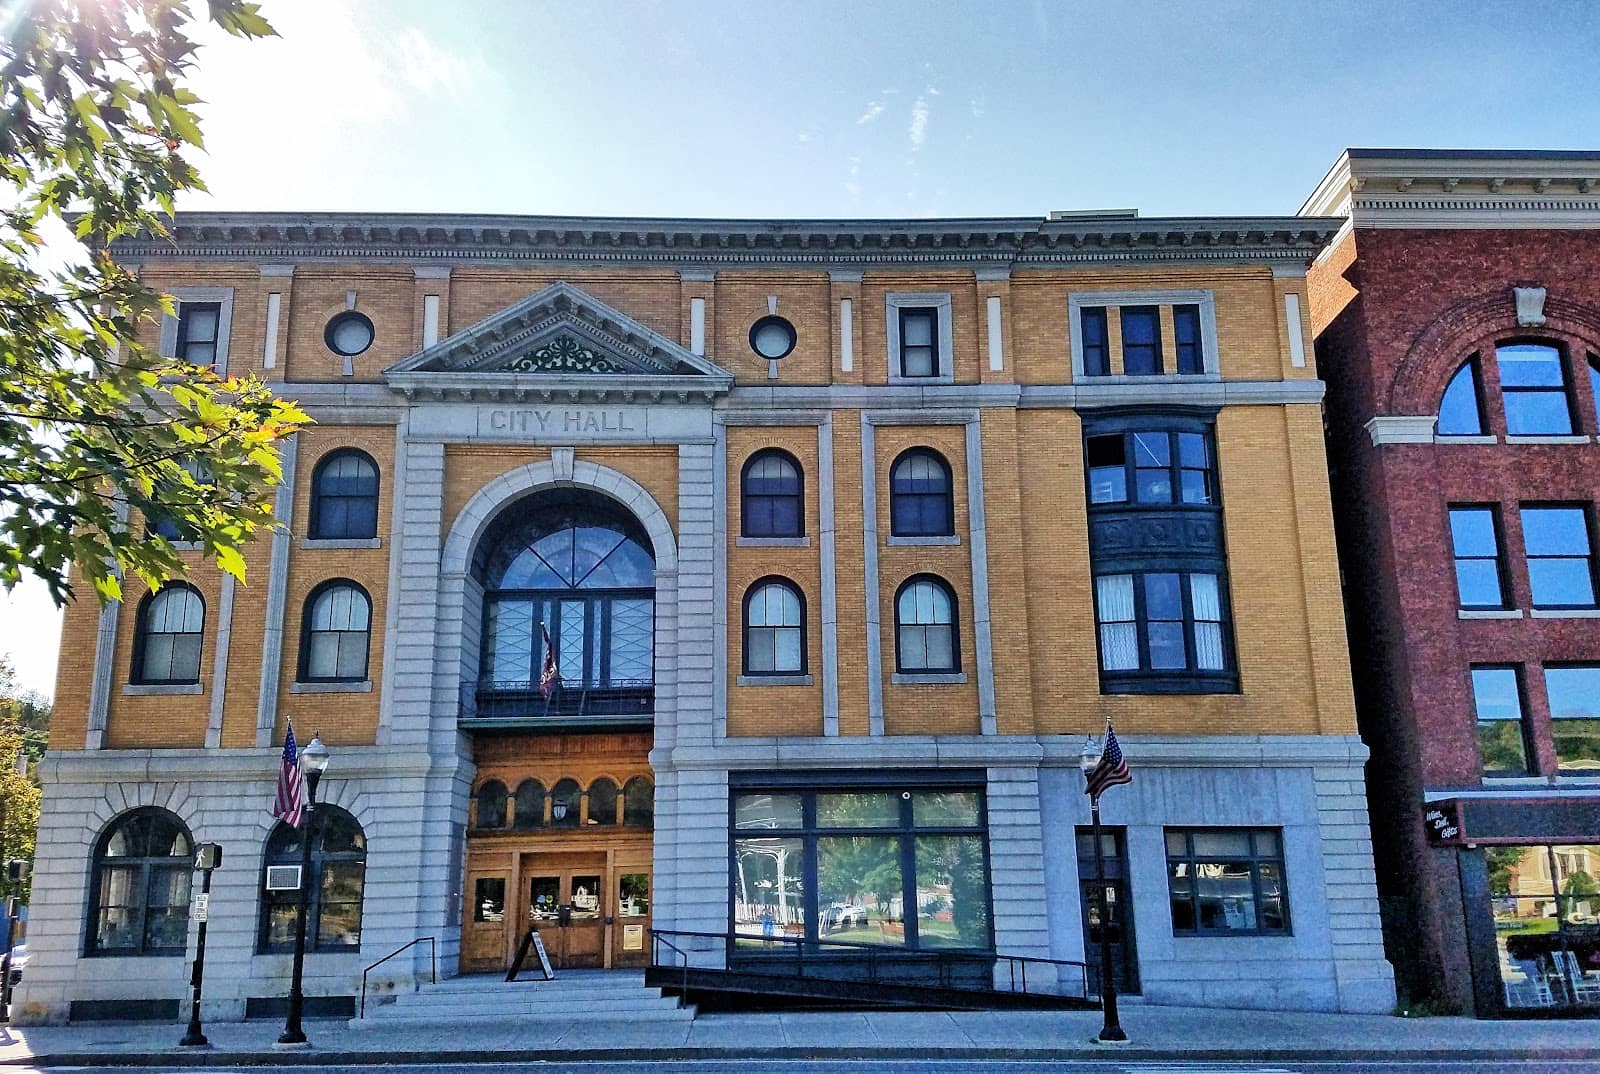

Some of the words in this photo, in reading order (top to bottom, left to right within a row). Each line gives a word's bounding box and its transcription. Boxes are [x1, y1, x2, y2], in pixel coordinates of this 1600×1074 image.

[490, 410, 551, 432] CITY
[564, 410, 635, 432] HALL
[1568, 911, 1600, 925] Ca
